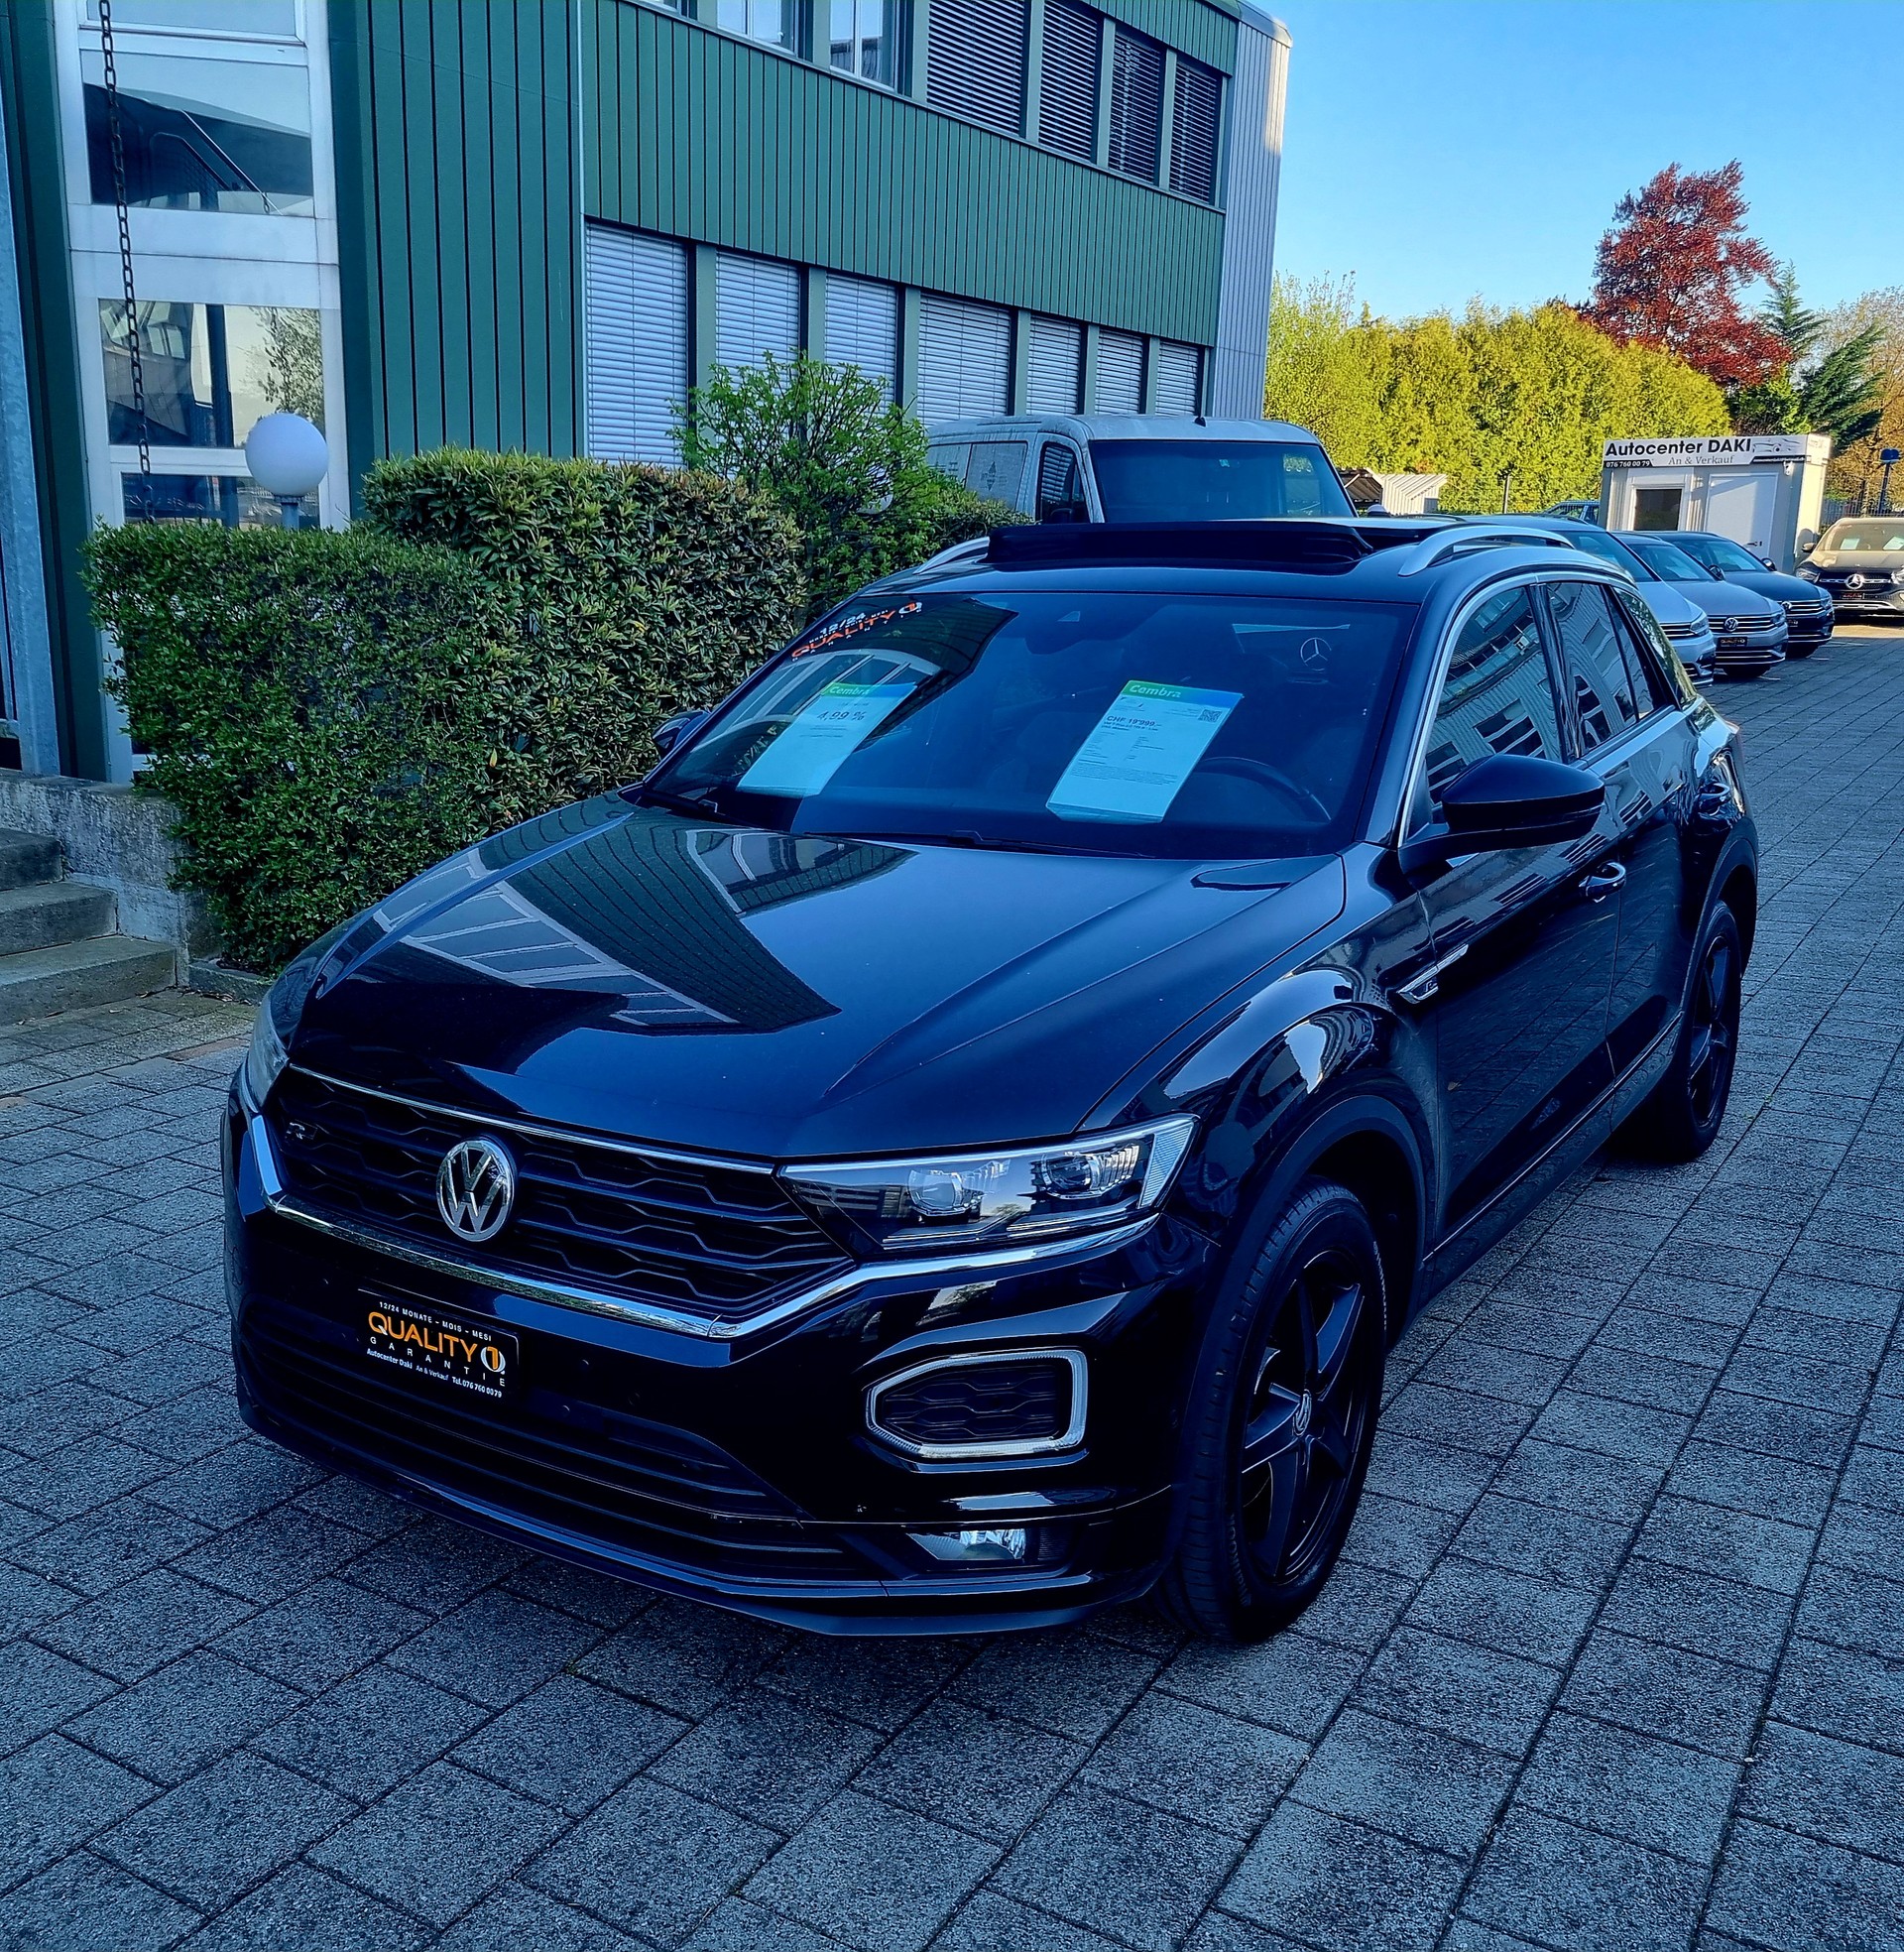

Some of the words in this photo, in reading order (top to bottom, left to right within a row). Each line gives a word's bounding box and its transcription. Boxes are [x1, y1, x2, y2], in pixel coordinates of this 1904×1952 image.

[1605, 440, 1703, 456] Autocenter
[1708, 438, 1751, 453] DAKI
[1668, 456, 1682, 465] An
[1696, 454, 1735, 464] Verkauf
[791, 609, 895, 658] QUALITY
[851, 710, 868, 721] %
[379, 1301, 400, 1313] 12/24
[402, 1307, 432, 1324] MONATE
[442, 1320, 462, 1333] MOIS
[472, 1329, 492, 1342] MESI
[368, 1311, 478, 1363] QUALITY
[367, 1348, 399, 1364] Autocenter
